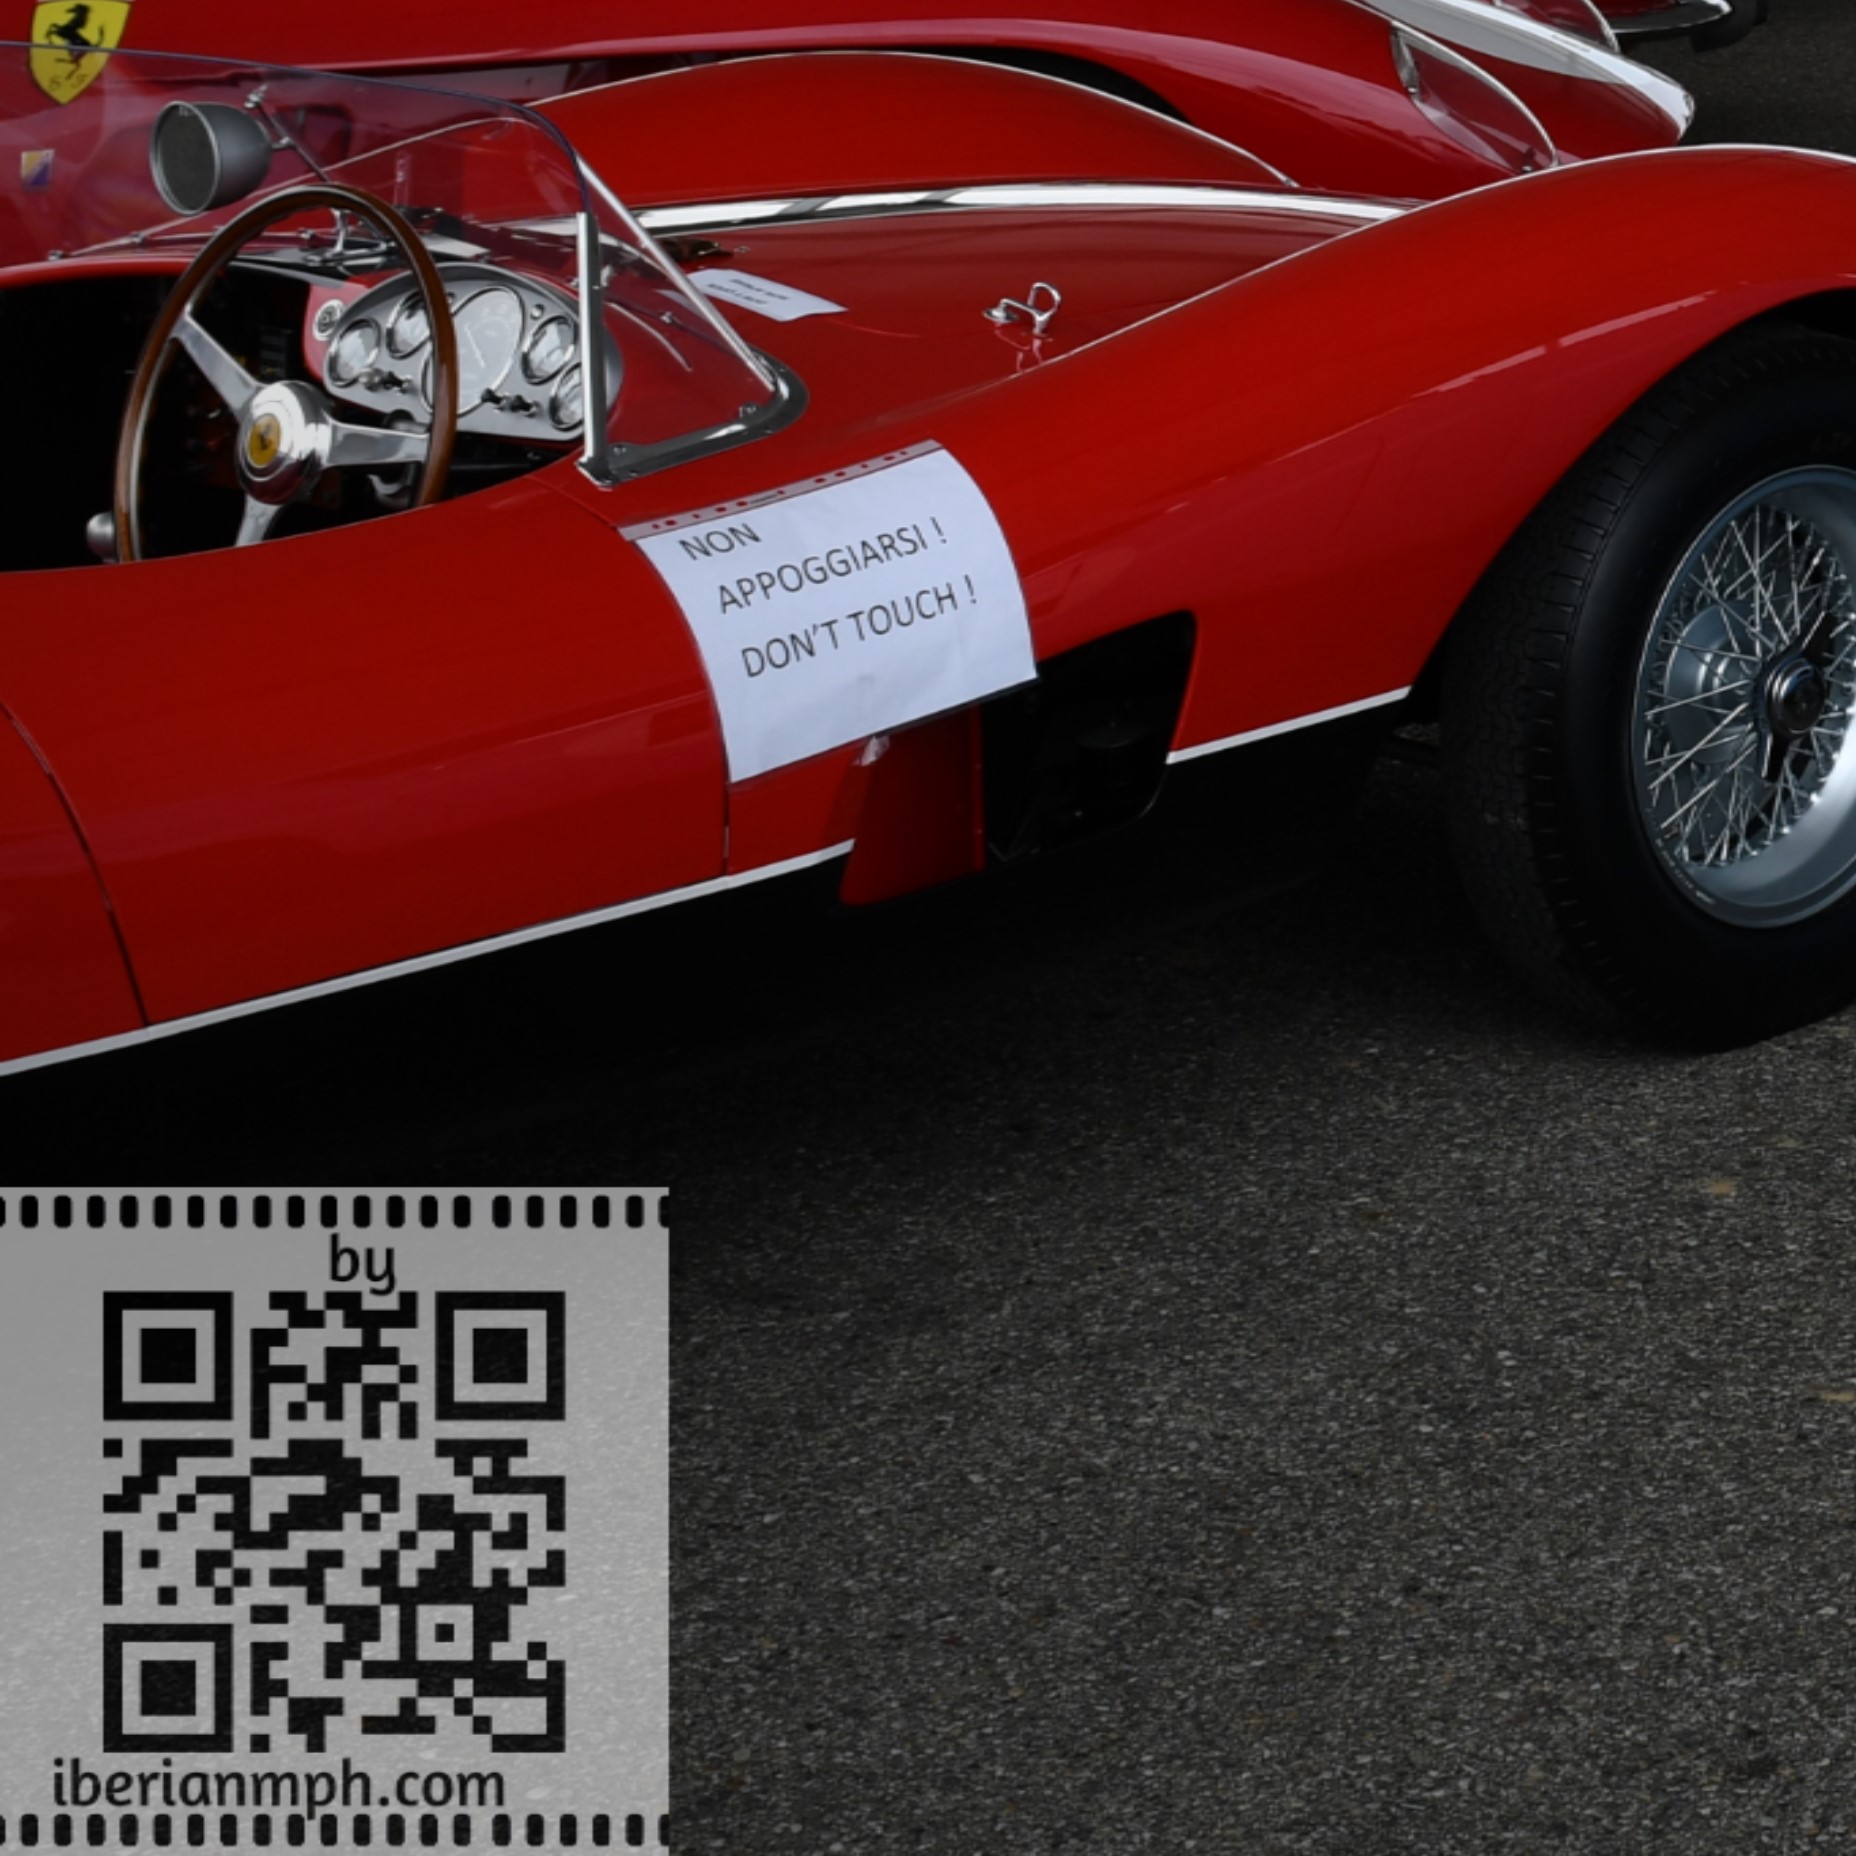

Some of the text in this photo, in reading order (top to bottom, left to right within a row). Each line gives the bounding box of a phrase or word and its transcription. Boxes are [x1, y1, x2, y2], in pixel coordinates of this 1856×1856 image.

[679, 523, 762, 561] NON
[718, 525, 929, 614] APPOGGIARSI
[741, 619, 840, 678] DON'T
[846, 582, 959, 642] TOUCH
